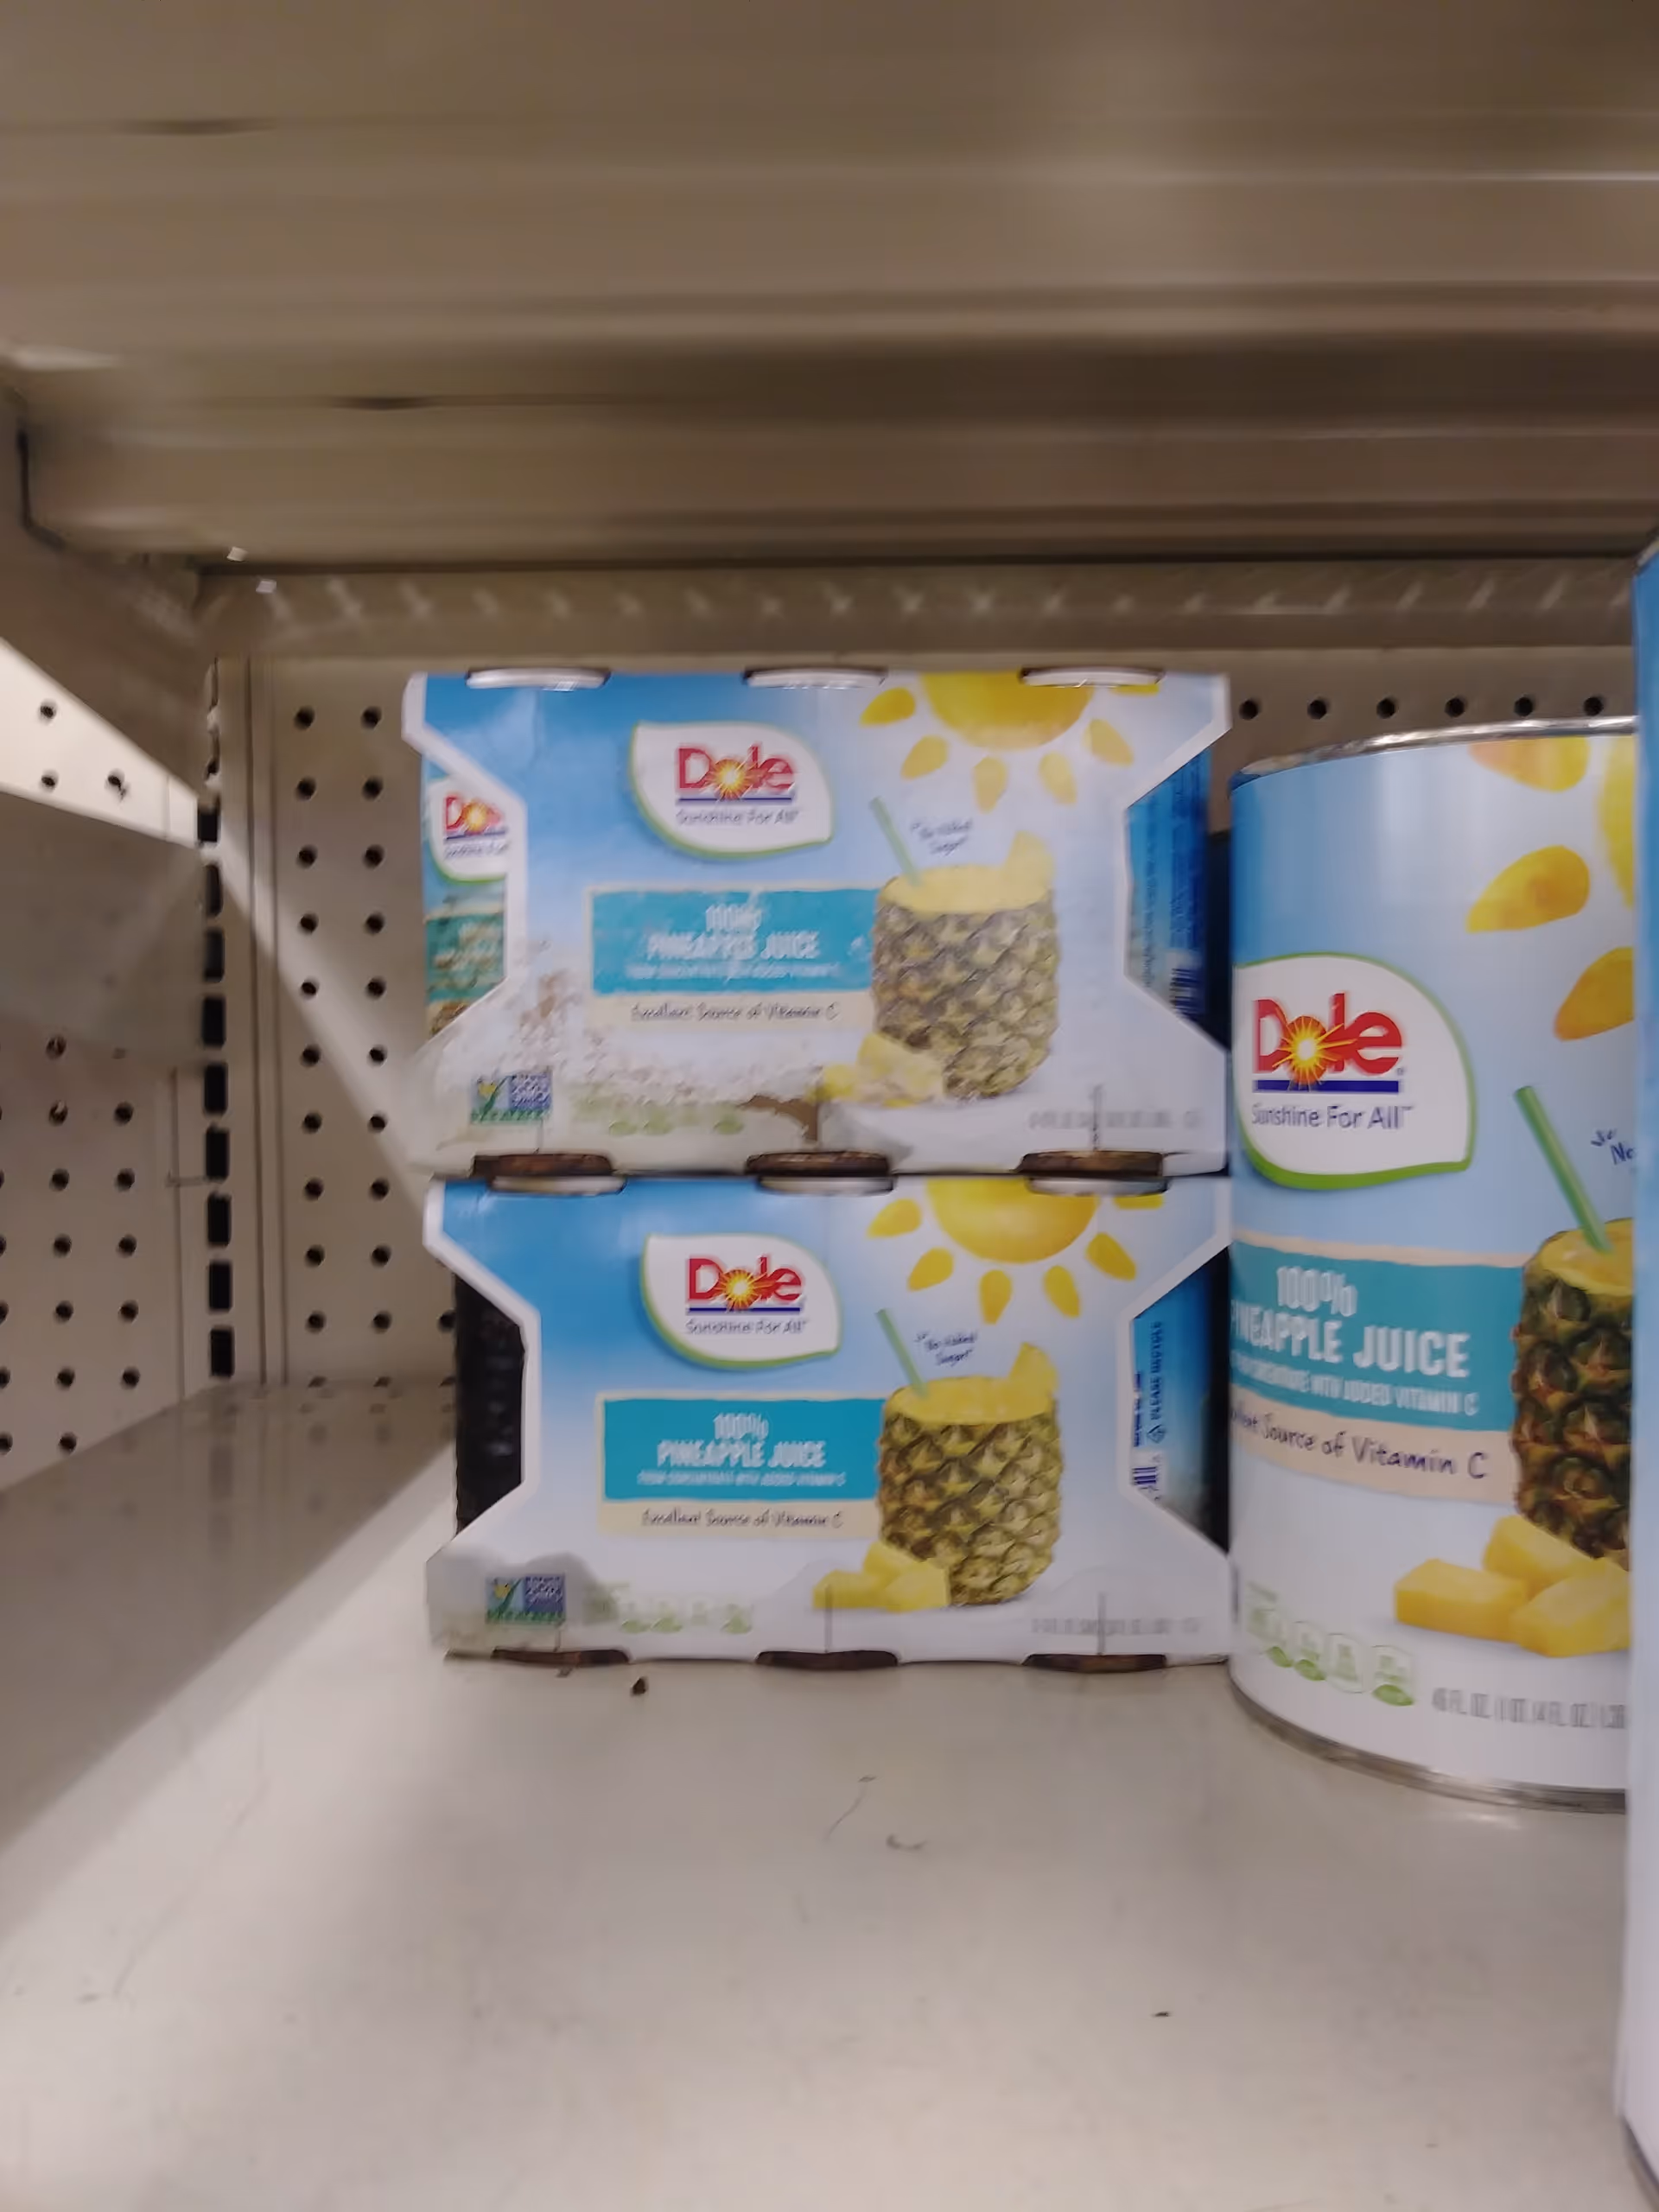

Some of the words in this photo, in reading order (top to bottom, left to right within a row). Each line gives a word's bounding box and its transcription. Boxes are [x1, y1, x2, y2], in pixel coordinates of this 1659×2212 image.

[677, 742, 796, 800] Dole
[1253, 993, 1402, 1085] Dole
[1253, 1102, 1321, 1128] Sunshine
[1326, 1105, 1363, 1128] For
[686, 1255, 802, 1311] Dole
[1277, 1266, 1357, 1317] 100%
[1353, 1325, 1471, 1377] JUICE
[1320, 1431, 1347, 1458] of
[1351, 1434, 1456, 1475] Vitamin
[1467, 1452, 1488, 1480] C
